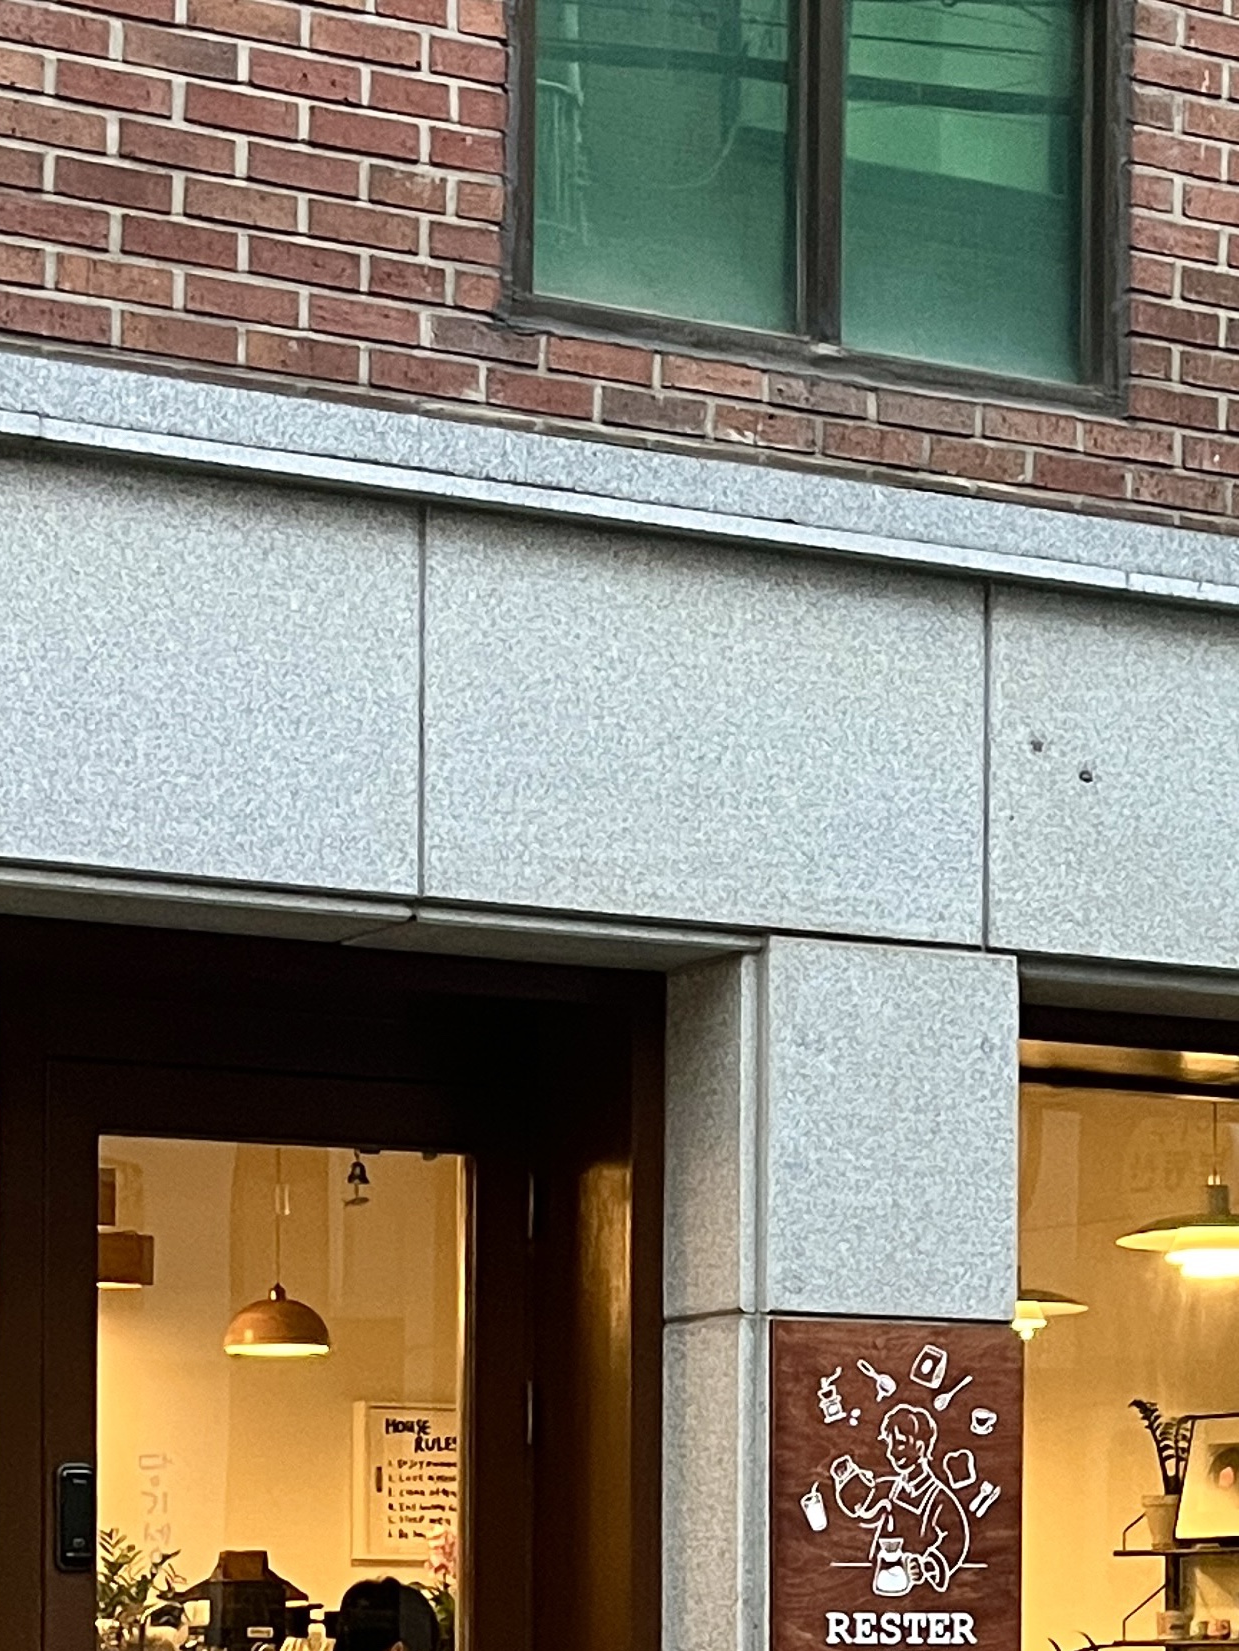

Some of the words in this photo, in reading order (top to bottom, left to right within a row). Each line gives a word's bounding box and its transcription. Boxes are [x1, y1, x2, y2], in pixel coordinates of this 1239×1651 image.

[385, 1417, 432, 1436] HOUSE
[414, 1436, 457, 1453] RULE
[825, 1612, 978, 1646] RESTER
